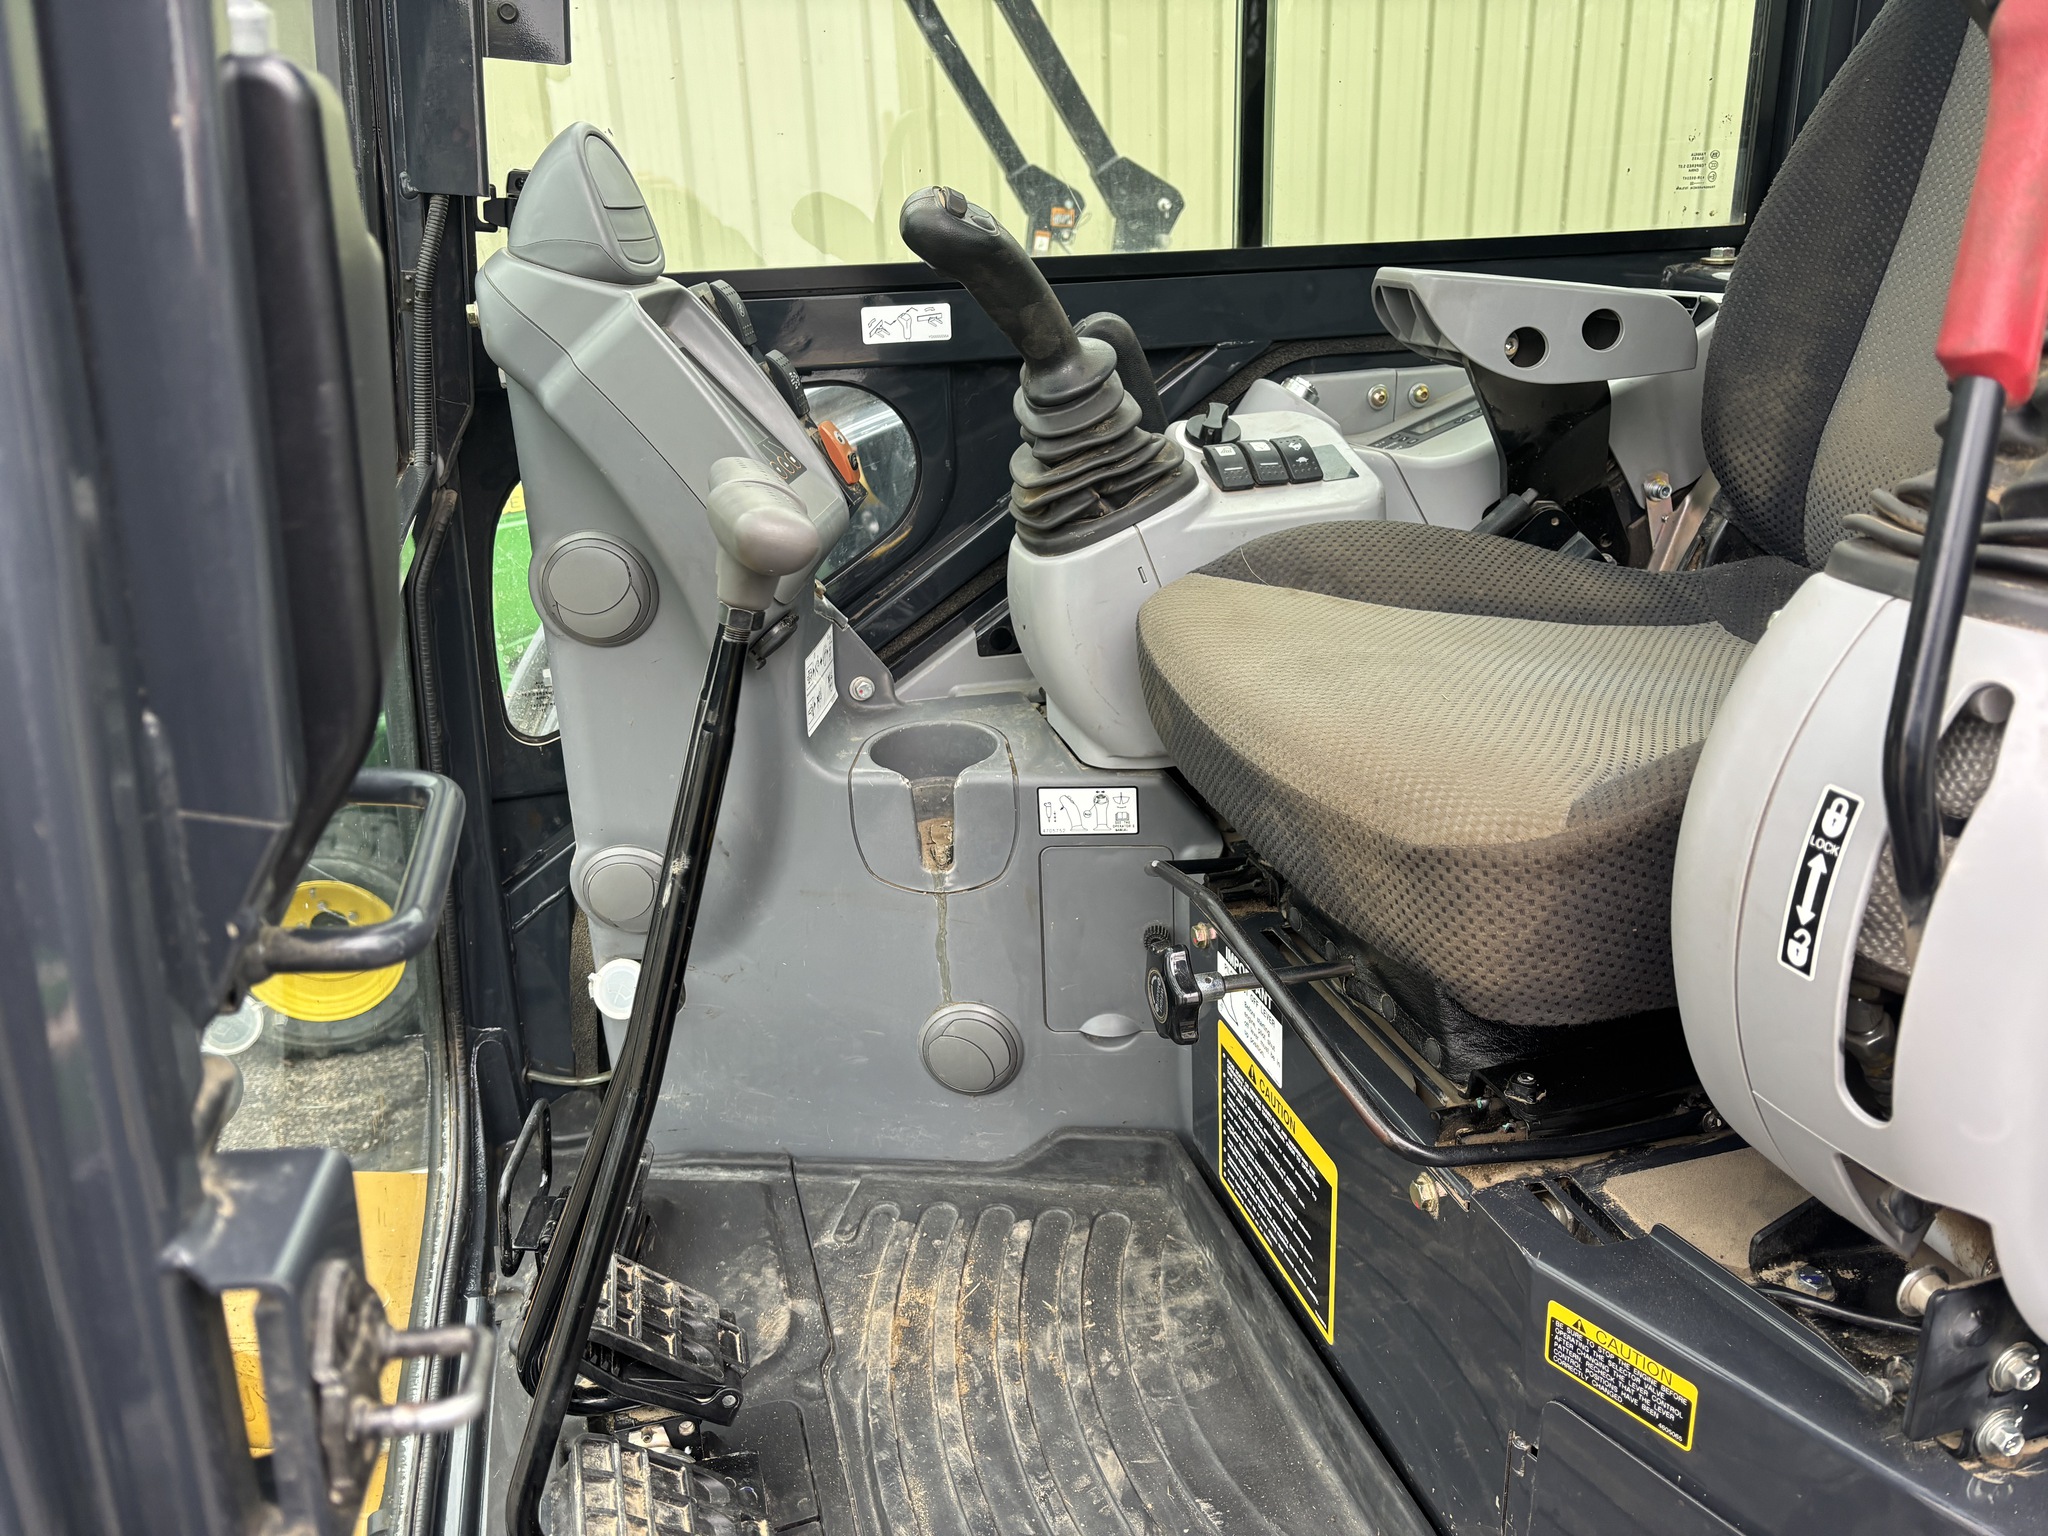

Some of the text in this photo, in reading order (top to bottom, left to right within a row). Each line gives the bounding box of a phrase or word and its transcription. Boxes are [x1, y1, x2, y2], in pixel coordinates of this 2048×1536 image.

[1809, 835, 1839, 856] LOCK
[1260, 1079, 1296, 1135] CAUTION
[1553, 1356, 1589, 1381] CORRECTLY
[1554, 1336, 1683, 1419] AFTER CHANGING THE LEVER CONTROL
[1554, 1342, 1675, 1422] PATTERN. RECHECK THAT THE LEVER
[1554, 1349, 1659, 1419] CONTROL POSITIONS HAVE BEEN
[1555, 1328, 1589, 1352] OPERATING
[1593, 1350, 1605, 1362] THE
[1608, 1360, 1640, 1385] SELECTOR
[1556, 1321, 1687, 1406] BE SURE TO STOP THE ENGINE BEFORE
[1596, 1330, 1672, 1386] CAUTION
